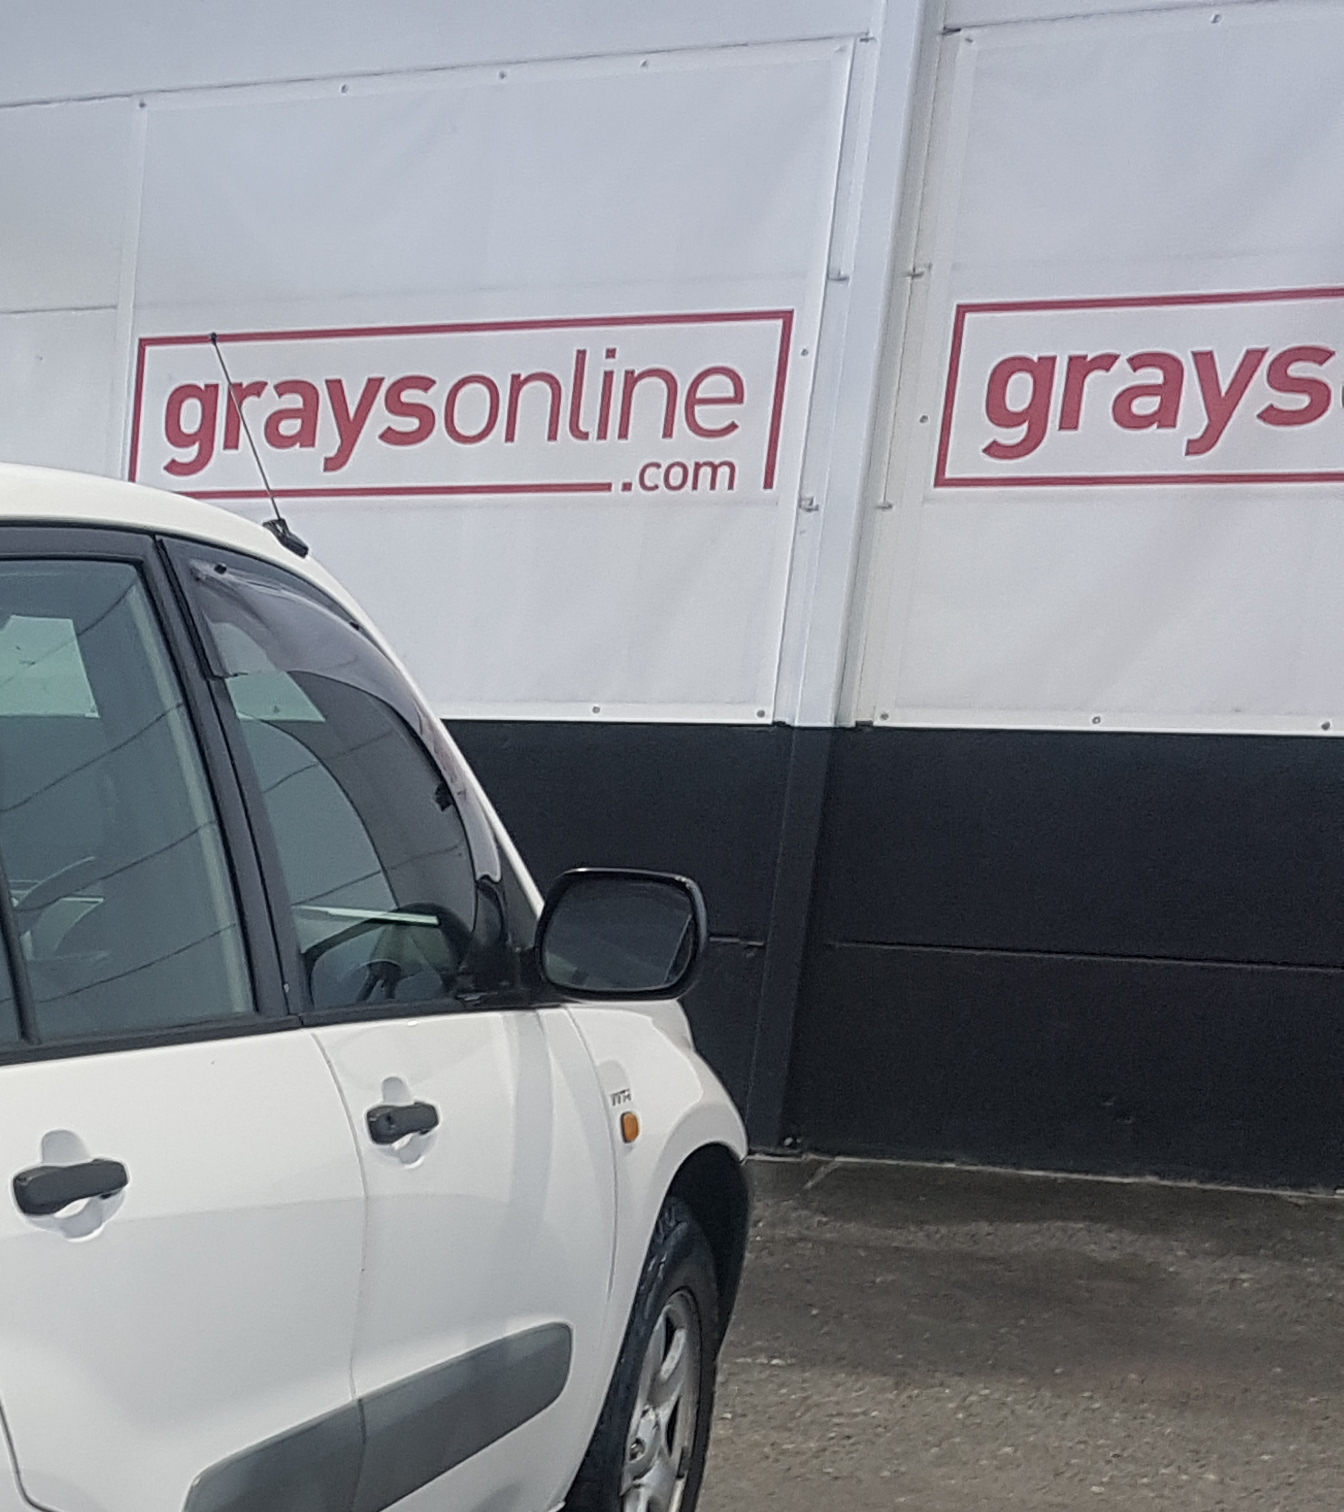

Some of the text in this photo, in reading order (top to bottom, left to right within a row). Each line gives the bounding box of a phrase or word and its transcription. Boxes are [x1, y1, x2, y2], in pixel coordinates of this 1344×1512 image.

[163, 348, 746, 476] graysonline
[981, 344, 1344, 460] grays
[620, 460, 737, 493] .com
